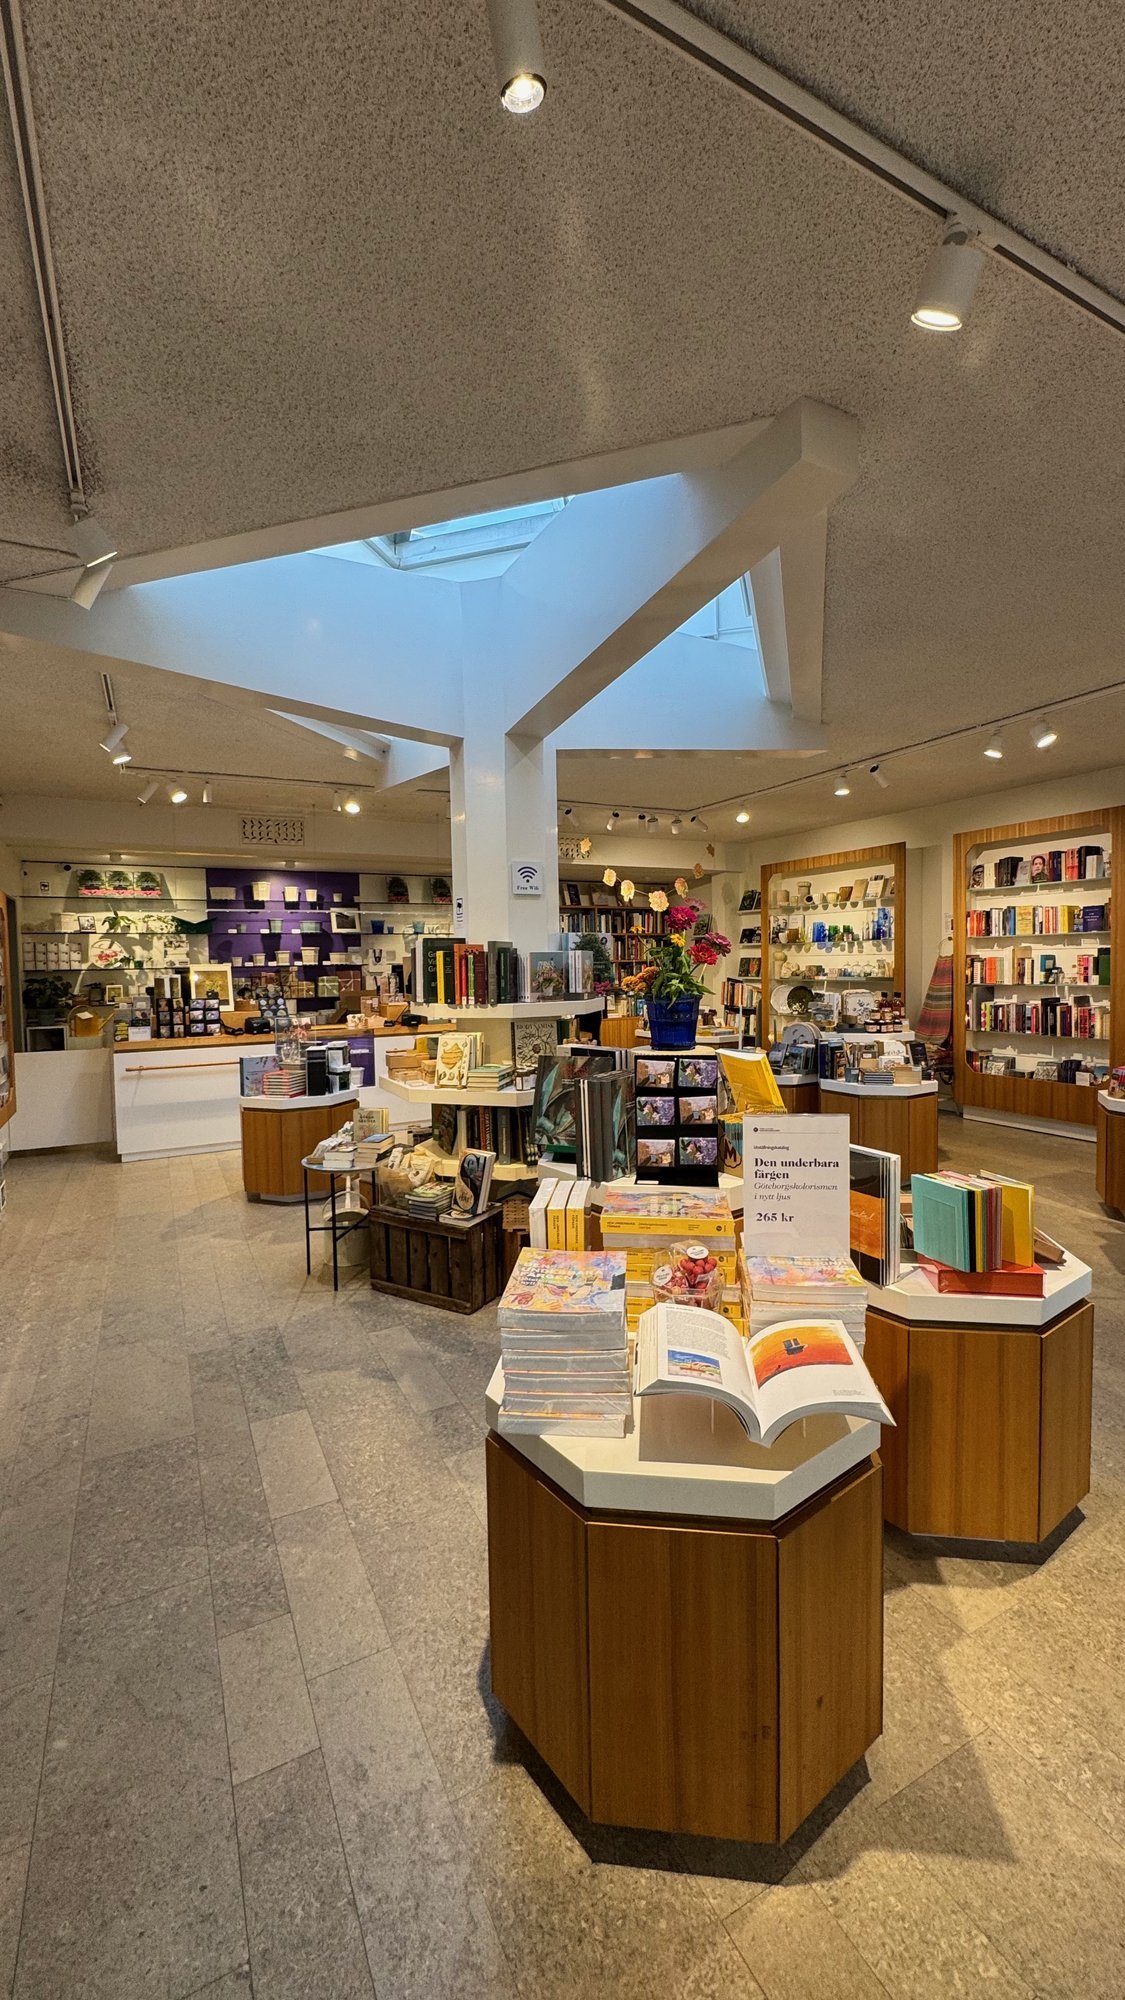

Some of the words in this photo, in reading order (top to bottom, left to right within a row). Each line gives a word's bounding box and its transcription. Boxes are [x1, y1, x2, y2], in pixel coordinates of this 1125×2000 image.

[754, 1157, 777, 1168] Den
[780, 1157, 840, 1168] underbara
[754, 1169, 790, 1181] färgen
[753, 1182, 838, 1192] Göteborgskolorismen
[759, 1193, 775, 1202] nytt
[776, 1193, 791, 1202] ljus
[756, 1212, 778, 1223] 265
[781, 1212, 795, 1223] kr
